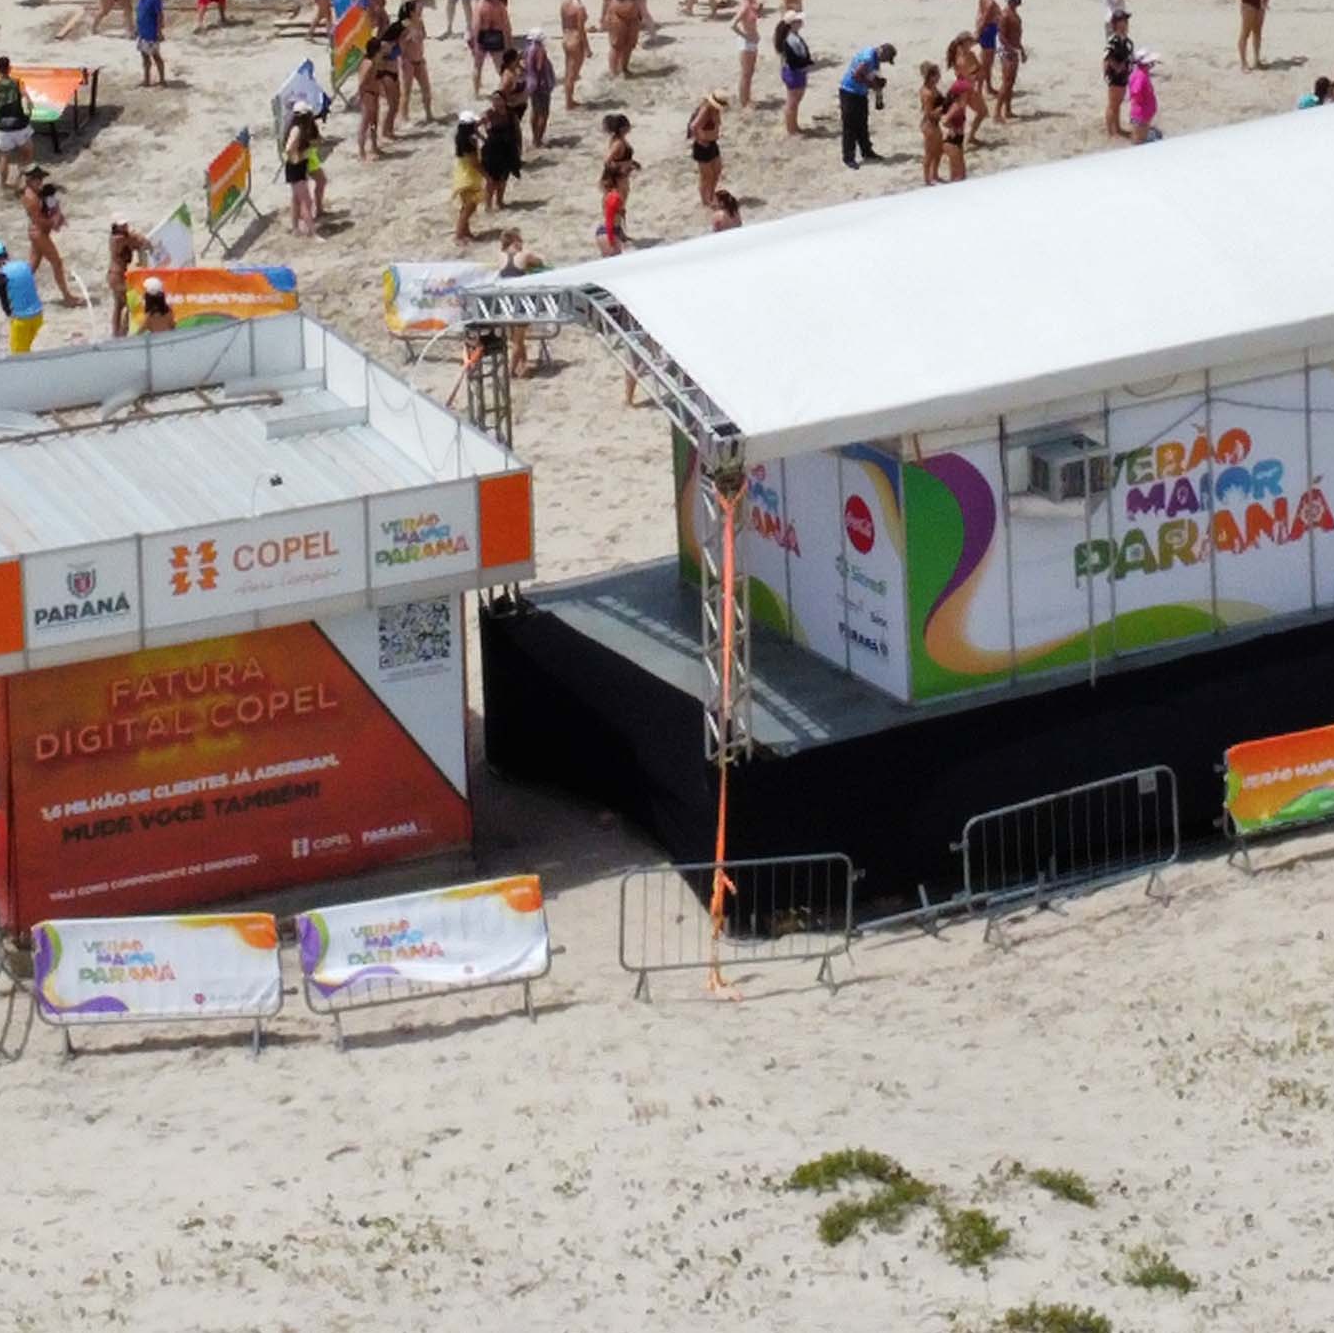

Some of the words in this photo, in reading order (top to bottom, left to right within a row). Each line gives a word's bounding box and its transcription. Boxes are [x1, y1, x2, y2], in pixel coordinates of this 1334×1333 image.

[232, 530, 341, 573] COPEL
[33, 590, 131, 627] PARANÁ
[110, 657, 266, 708] FATURA
[35, 710, 193, 762] DIGITAL
[210, 681, 340, 728] COPEL
[62, 815, 133, 844] MUDE
[138, 799, 207, 831] VOCÊ
[212, 780, 322, 815] TAMBÉM!
[63, 793, 128, 818] MILHÃO
[128, 787, 153, 805] DE
[153, 774, 228, 800] CLIENTES
[230, 767, 251, 788] JÁ
